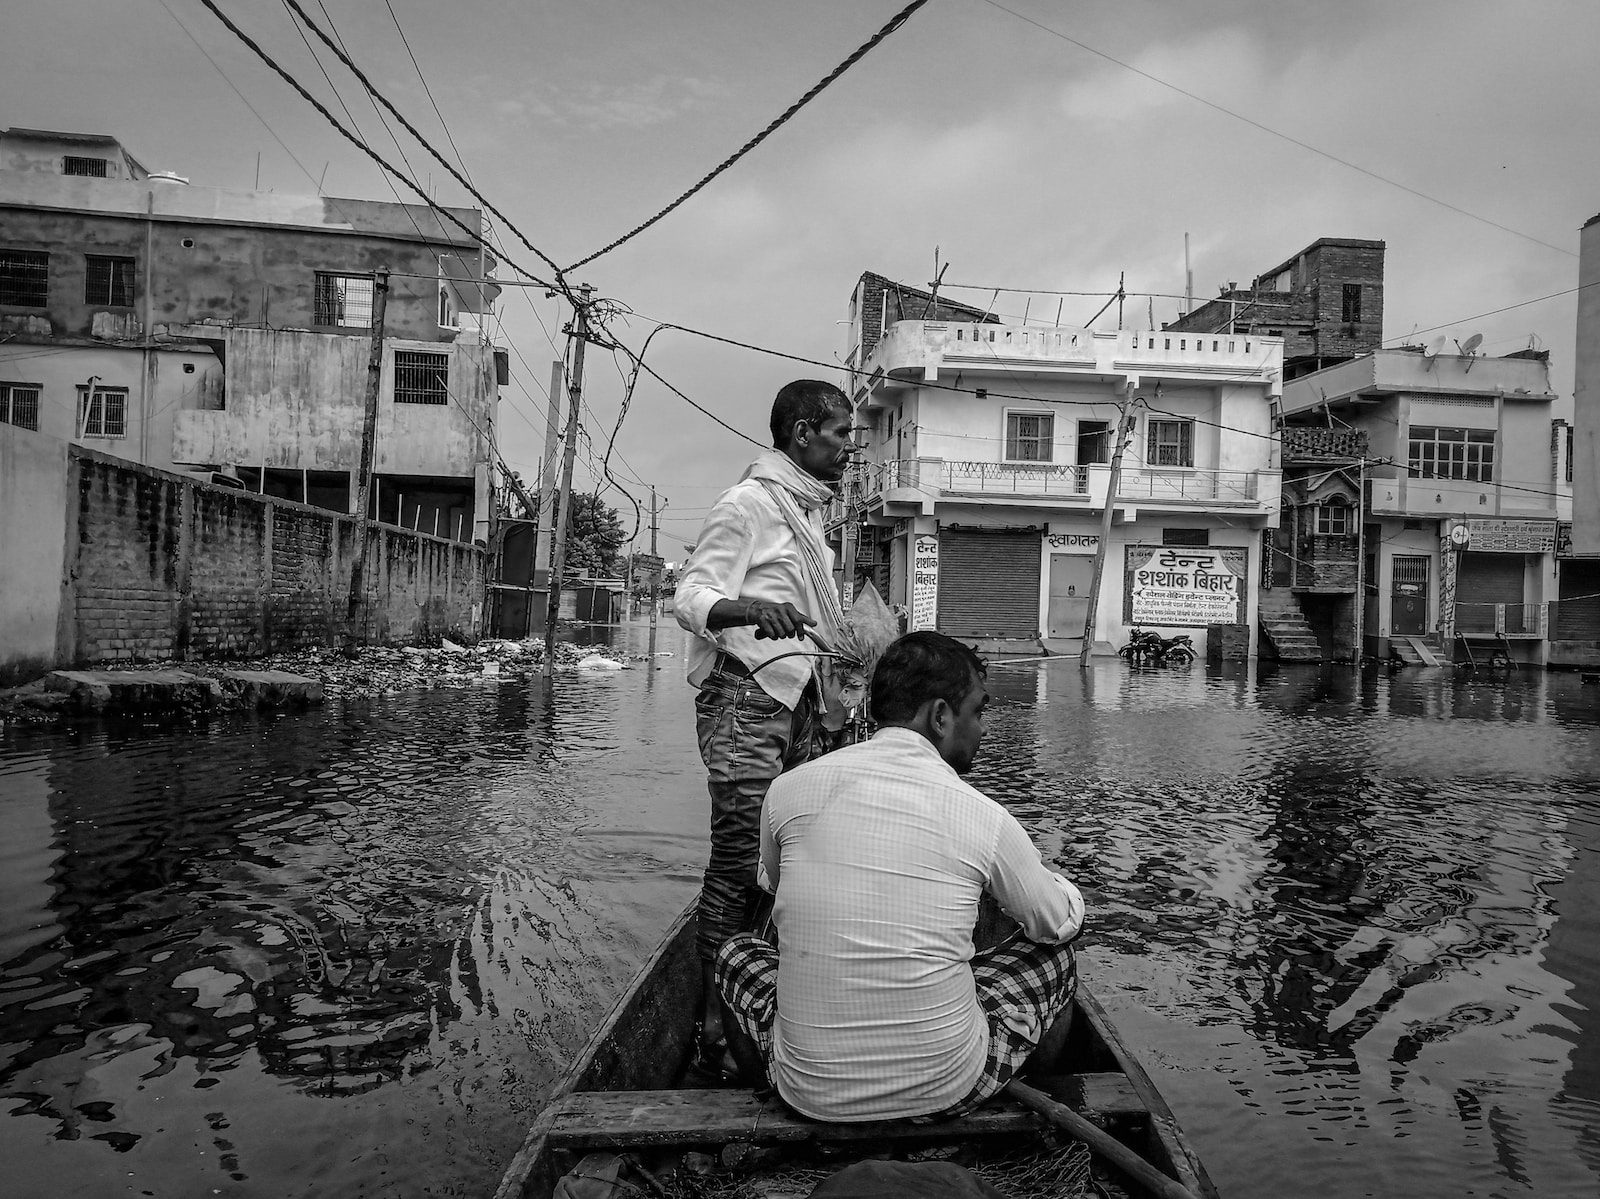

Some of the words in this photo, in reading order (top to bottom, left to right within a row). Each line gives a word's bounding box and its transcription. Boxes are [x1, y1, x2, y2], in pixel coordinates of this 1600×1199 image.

[916, 540, 937, 554] टेन्ट
[915, 556, 938, 569] शशांक
[1159, 550, 1216, 569] टेन्ट
[1137, 568, 1188, 588] शशांक
[1192, 569, 1234, 592] बिहार
